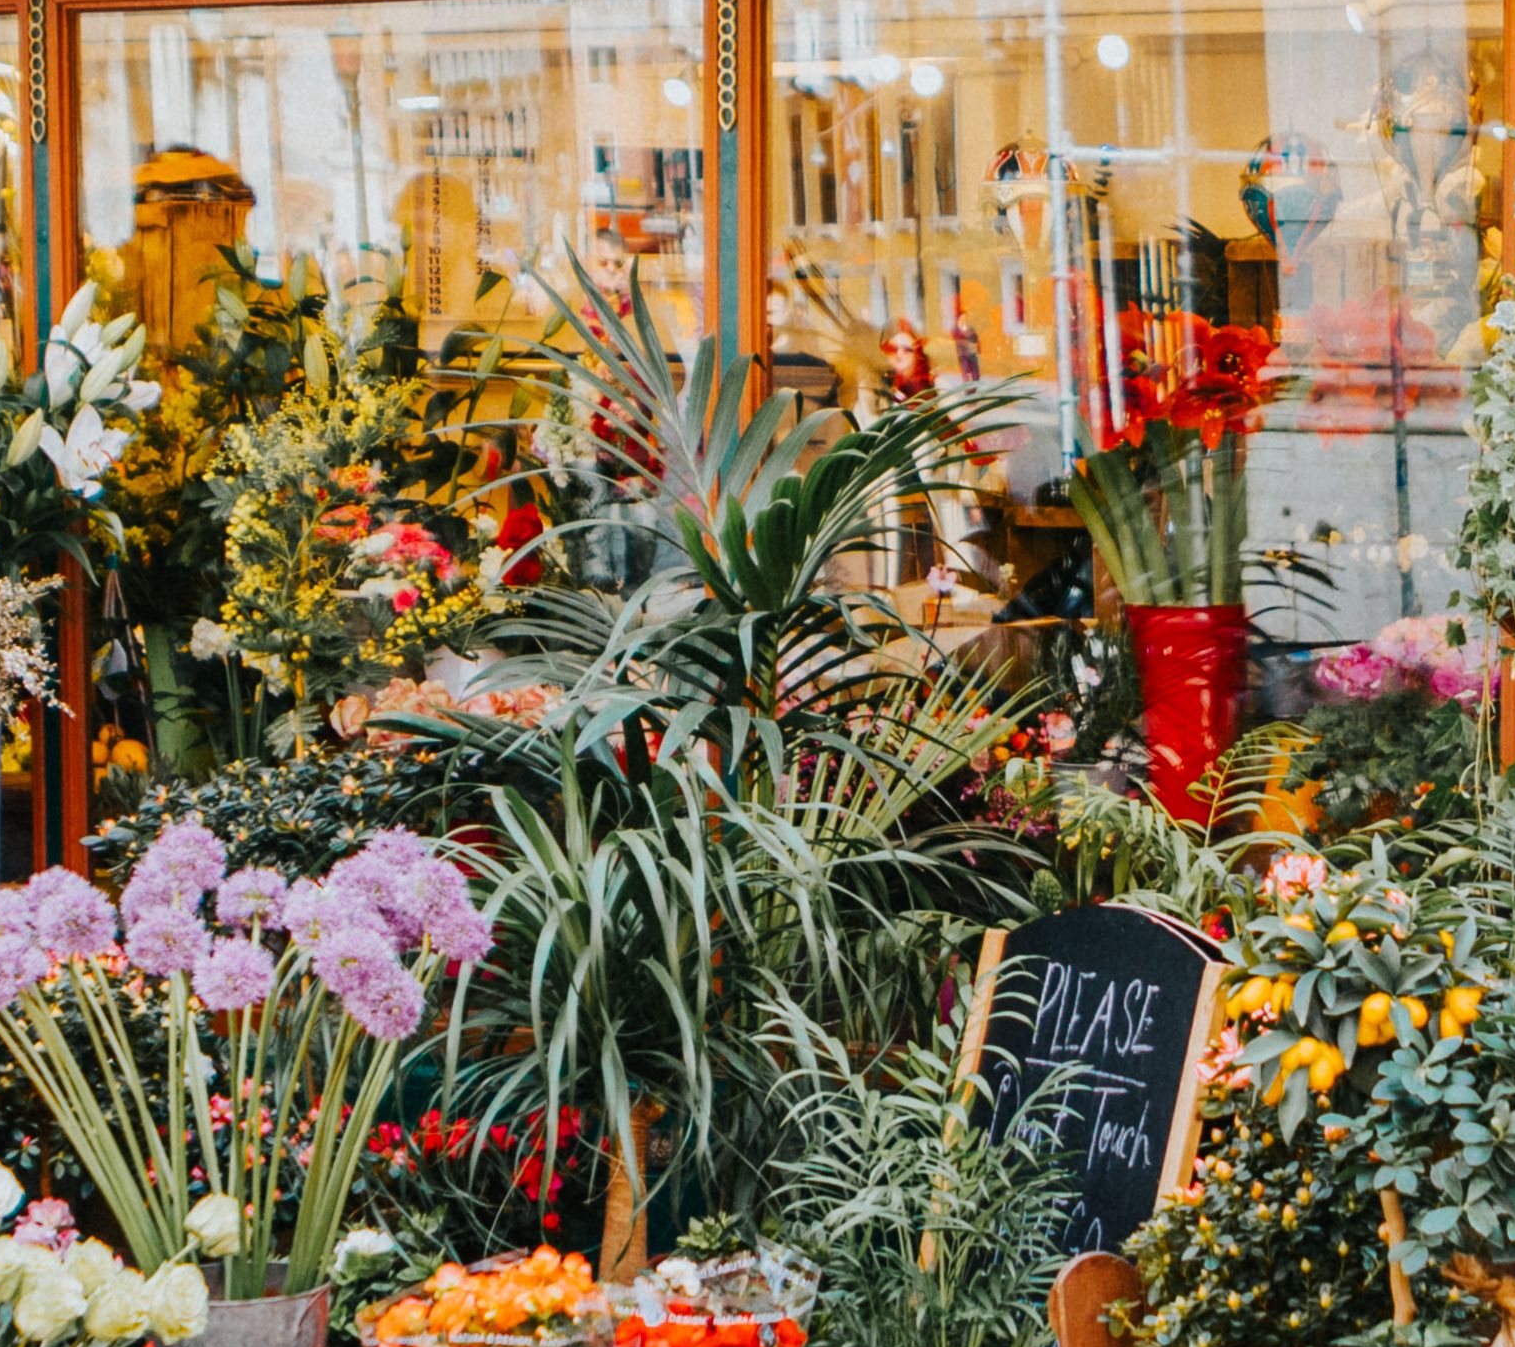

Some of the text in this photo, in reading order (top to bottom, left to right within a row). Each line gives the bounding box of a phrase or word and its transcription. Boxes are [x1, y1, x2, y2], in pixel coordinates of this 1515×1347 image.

[433, 177, 441, 186] 3
[433, 187, 441, 196] 4
[433, 197, 441, 206] 5
[429, 247, 442, 255] 10
[429, 257, 442, 265] 11
[429, 267, 442, 275] 12
[429, 277, 442, 285] 13
[429, 287, 442, 295] 14
[429, 296, 442, 305] 15
[429, 306, 442, 315] 16
[1033, 962, 1161, 1057] PLEASE
[1087, 1087, 1151, 1170] Touch
